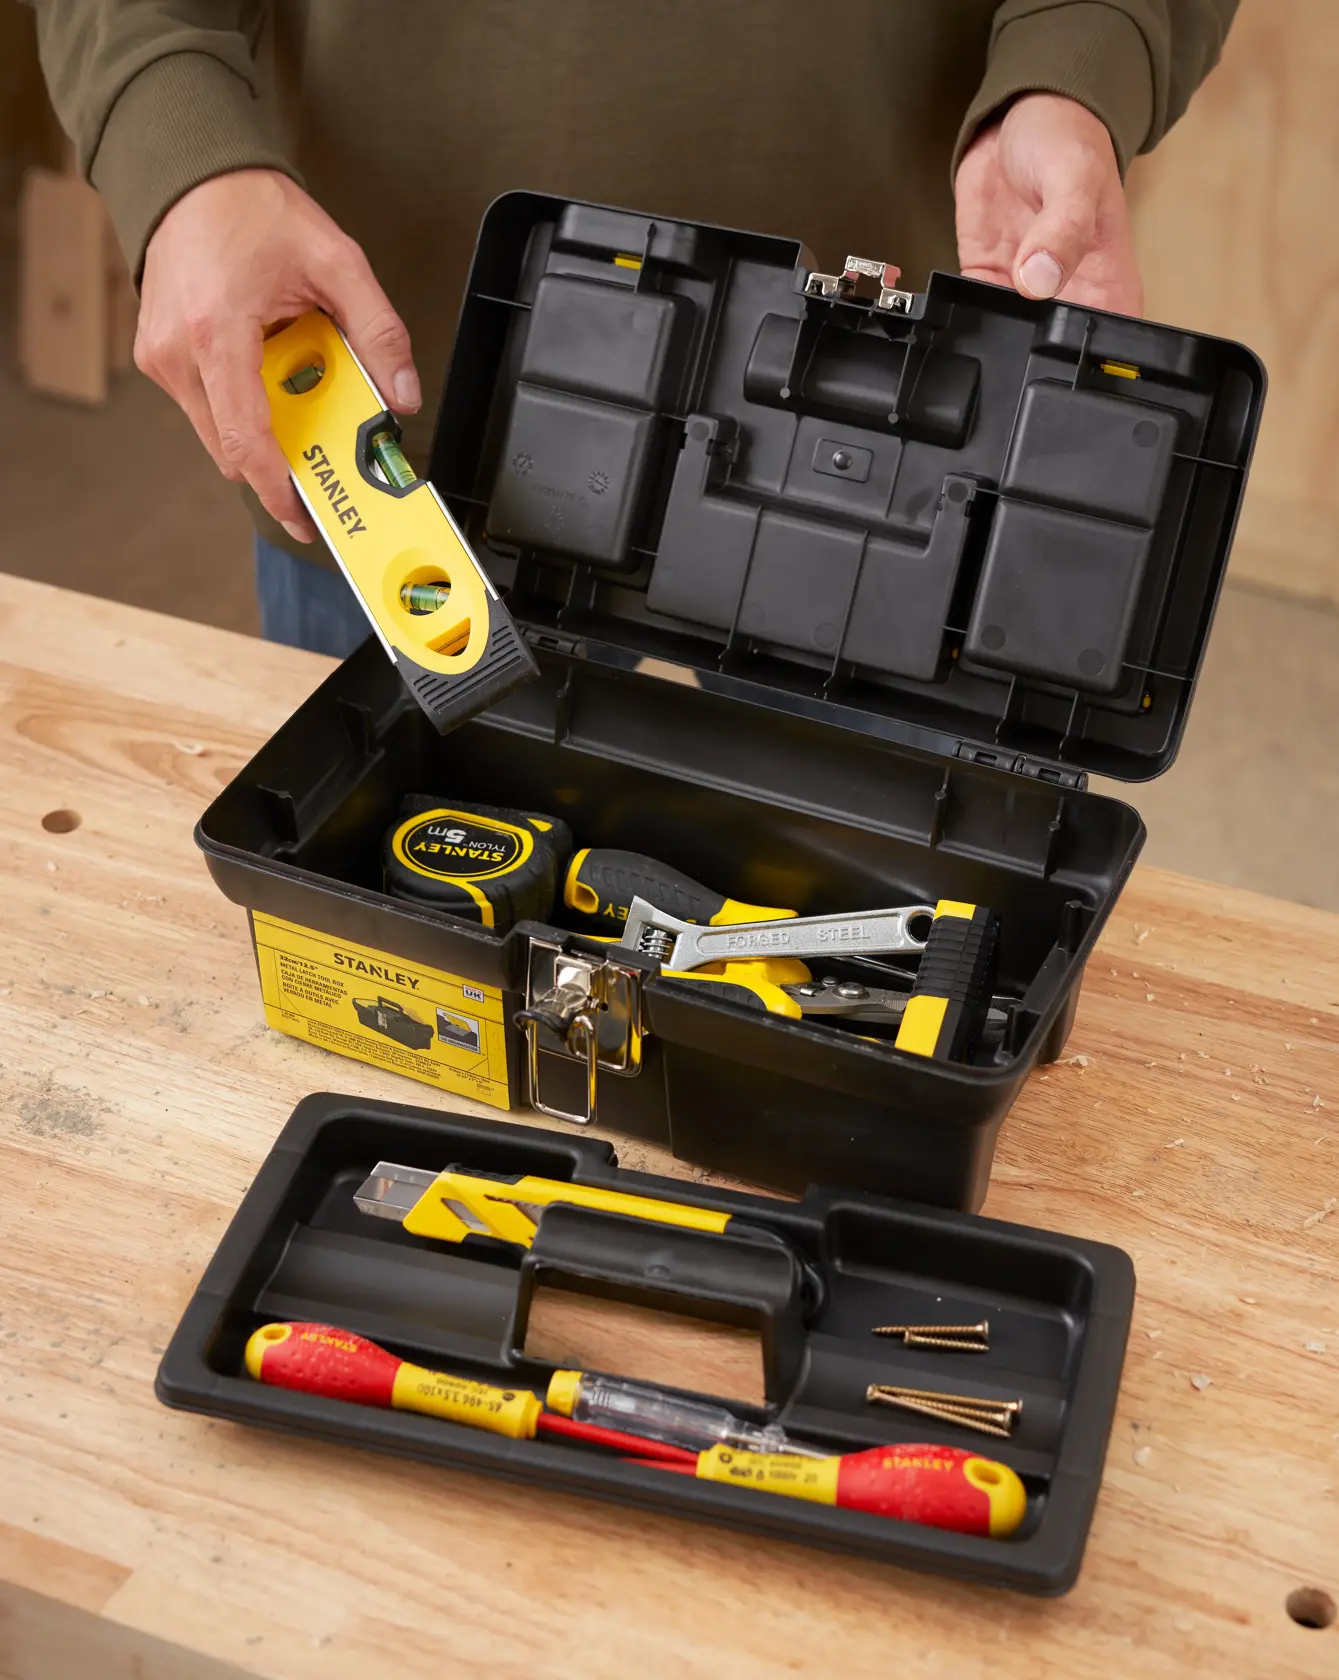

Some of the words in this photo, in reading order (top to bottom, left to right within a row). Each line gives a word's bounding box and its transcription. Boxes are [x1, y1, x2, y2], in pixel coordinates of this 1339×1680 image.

[302, 444, 367, 540] STANLEY
[427, 825, 467, 844] 5m
[413, 841, 504, 862] STANLEY
[468, 841, 506, 852] TYLON
[726, 931, 791, 949] FORGED
[817, 925, 870, 943] STEEL
[280, 962, 300, 973] METAL
[333, 952, 420, 991] STANLEY
[281, 974, 294, 983] CON
[281, 969, 296, 978] CAJA
[304, 977, 348, 996] HERRAMIENTAS
[324, 996, 339, 1005] AVEC
[465, 989, 482, 1000] UK
[300, 1331, 358, 1353] STANLEY
[882, 1456, 954, 1473] STANLEY
